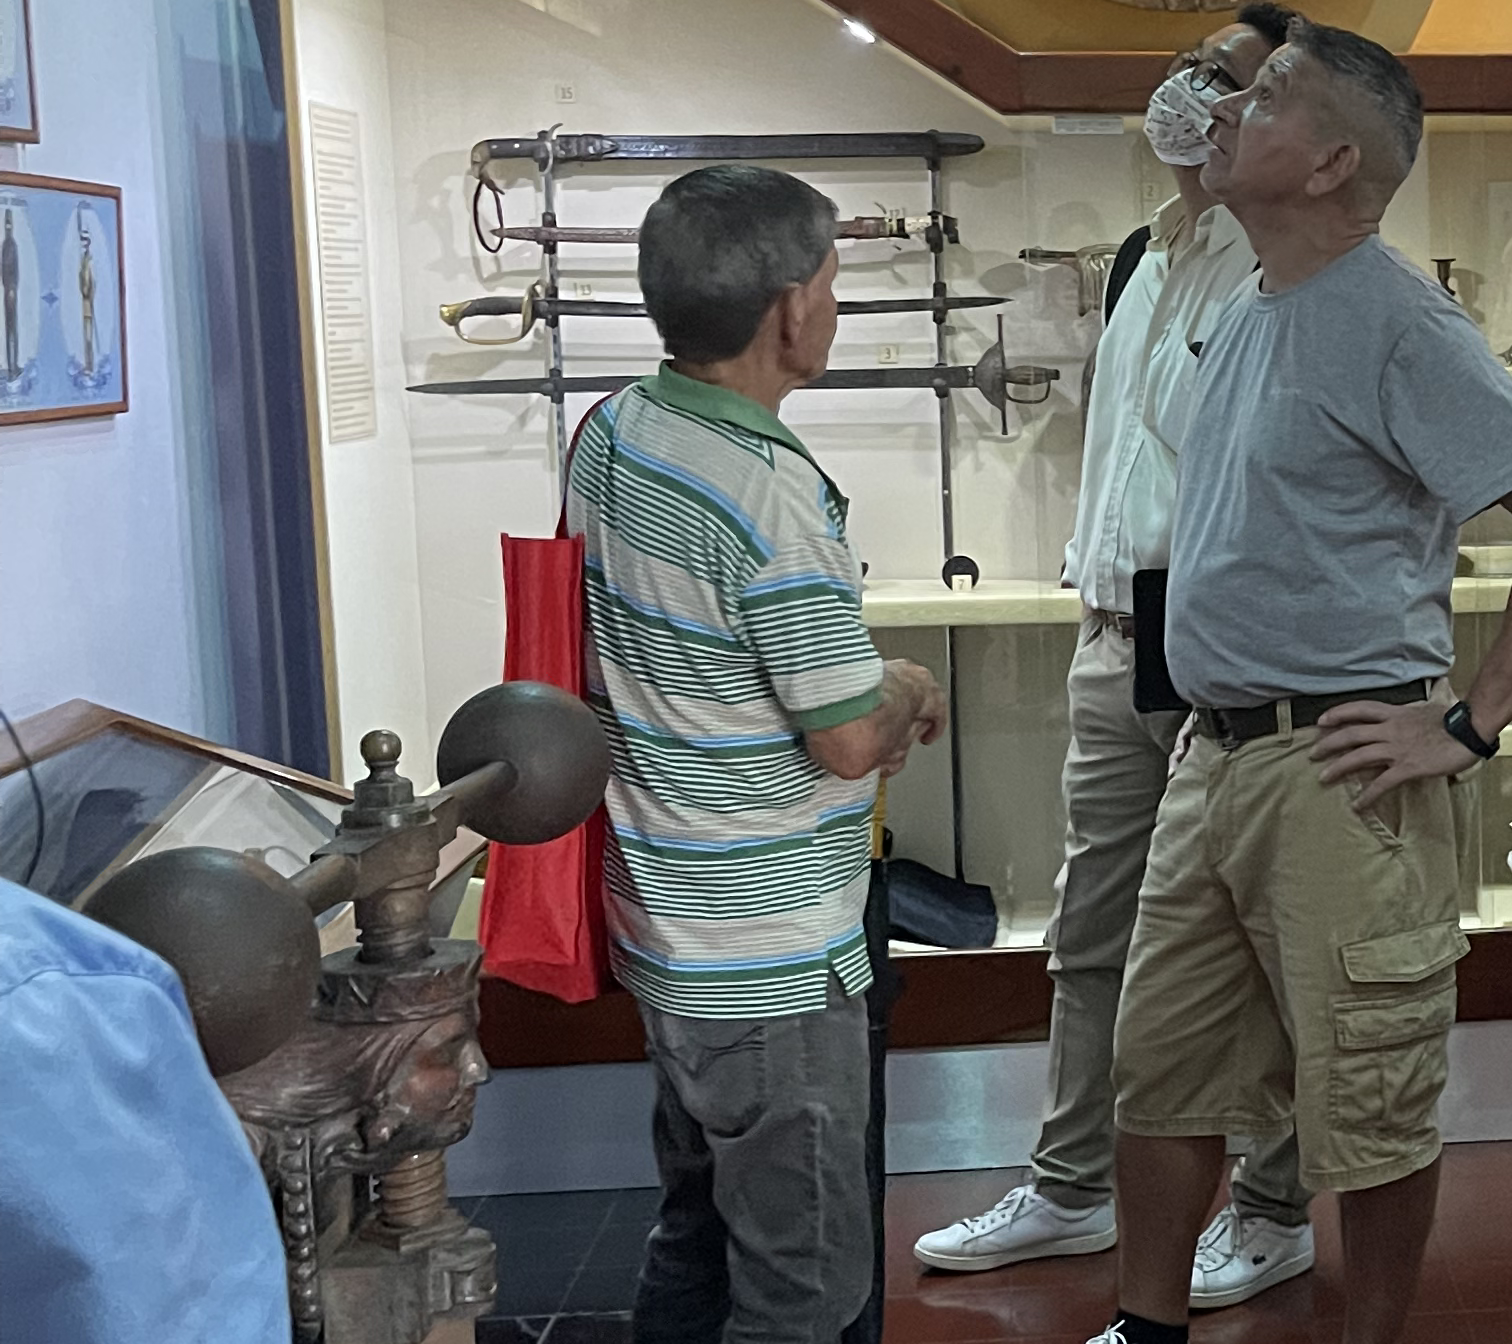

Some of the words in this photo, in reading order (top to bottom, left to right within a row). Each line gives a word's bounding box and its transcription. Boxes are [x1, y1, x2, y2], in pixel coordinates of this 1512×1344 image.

[561, 87, 573, 100] 15
[884, 347, 891, 360] 3
[957, 578, 965, 591] 7
